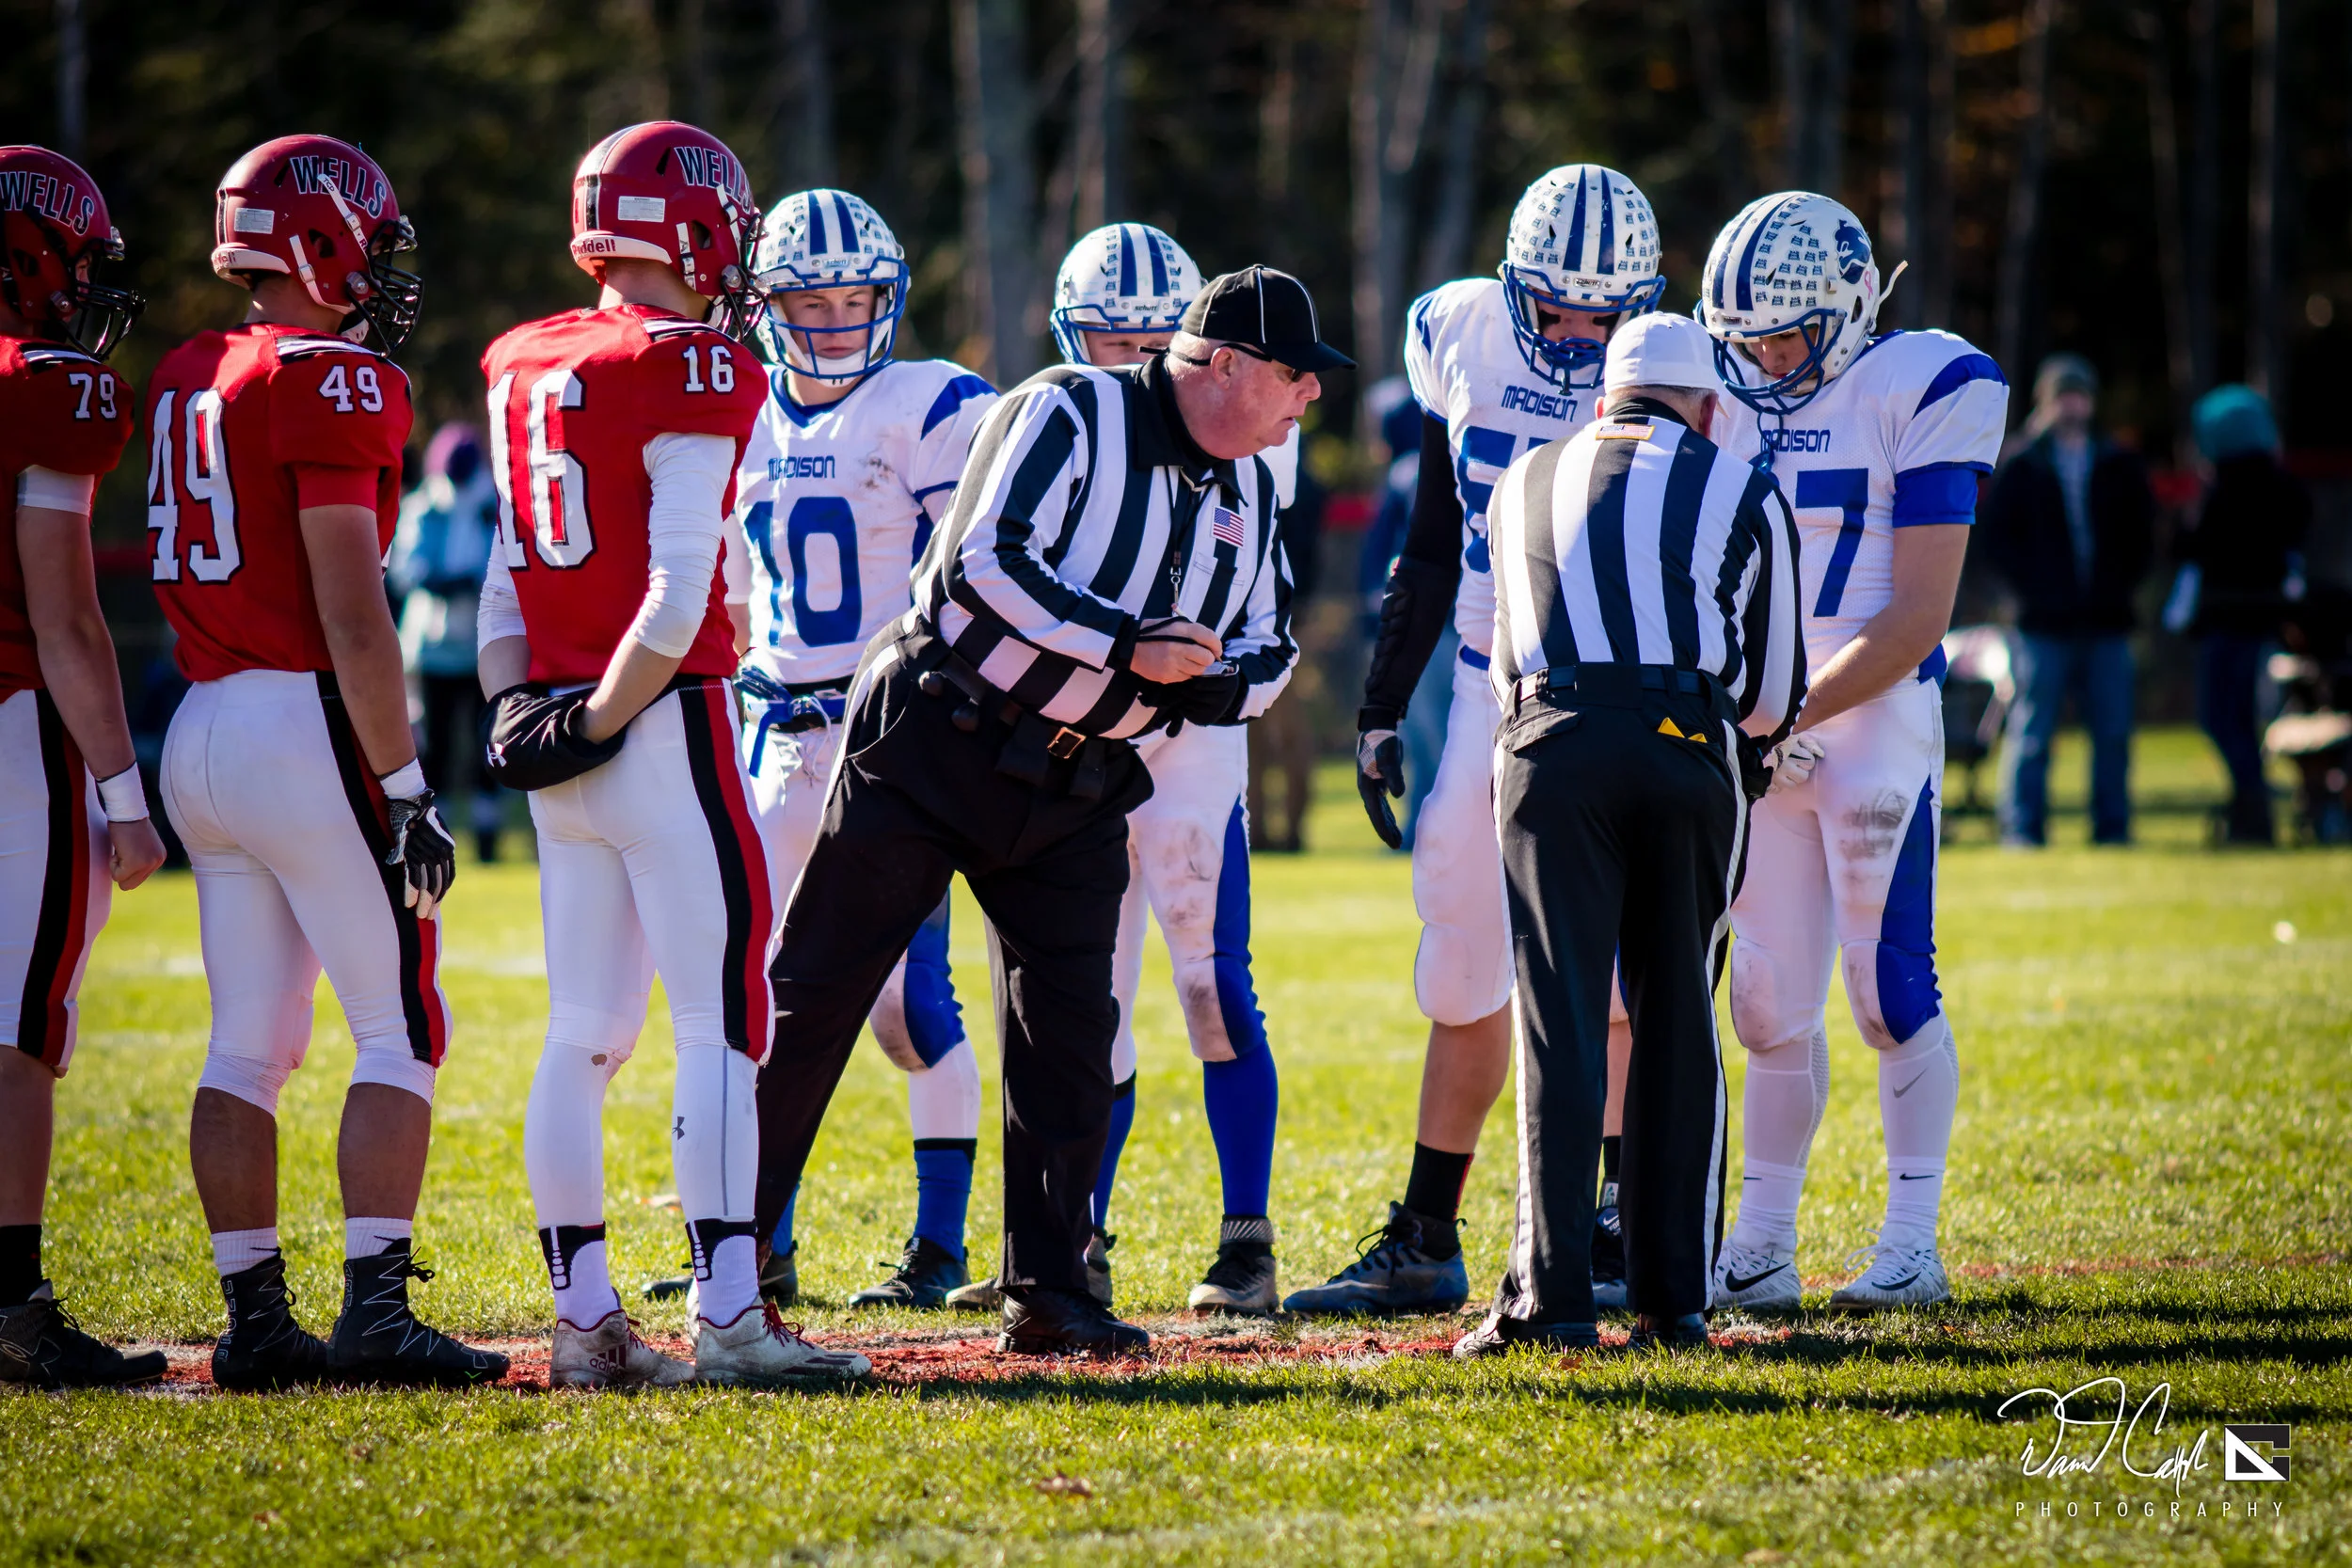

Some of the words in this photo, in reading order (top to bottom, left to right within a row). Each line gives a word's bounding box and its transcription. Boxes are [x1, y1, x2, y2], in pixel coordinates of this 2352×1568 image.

[0, 171, 94, 236] WELLS
[290, 154, 387, 219] WELLS
[69, 372, 119, 421] 79
[318, 364, 385, 414] 49
[682, 344, 736, 393] 16
[1501, 385, 1579, 422] MADISON
[147, 388, 246, 585] 49
[487, 366, 598, 572] 16
[768, 455, 835, 481] MADISON
[743, 496, 863, 648] 10
